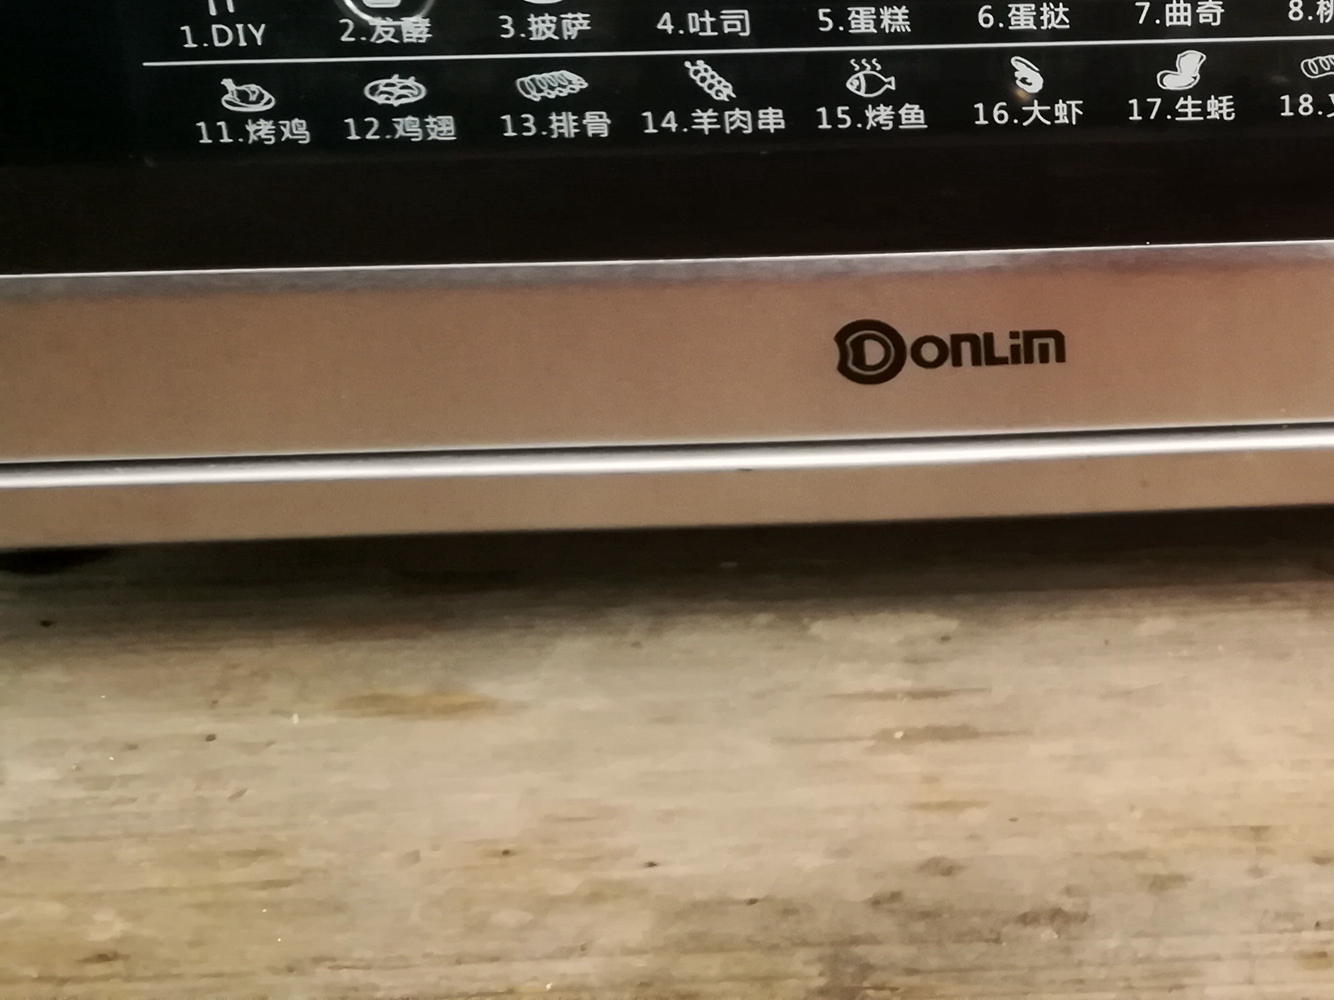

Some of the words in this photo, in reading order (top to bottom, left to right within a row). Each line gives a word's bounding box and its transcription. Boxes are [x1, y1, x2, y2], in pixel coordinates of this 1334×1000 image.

[498, 11, 592, 40] 3.披萨
[655, 9, 751, 38] 4.吐司
[817, 5, 912, 35] 5.蛋糕
[977, 2, 1072, 32] 6.蛋挞
[180, 21, 267, 49] 1.DIY
[640, 106, 787, 136] 14.羊肉串
[815, 102, 929, 132] 15.烤鱼
[972, 99, 1085, 128] 16.大虾
[1127, 94, 1236, 122] 17.生蚝
[195, 117, 312, 146] 11.烤鸡
[343, 114, 458, 143] 12.鸡翅
[500, 110, 613, 139] 13.排骨
